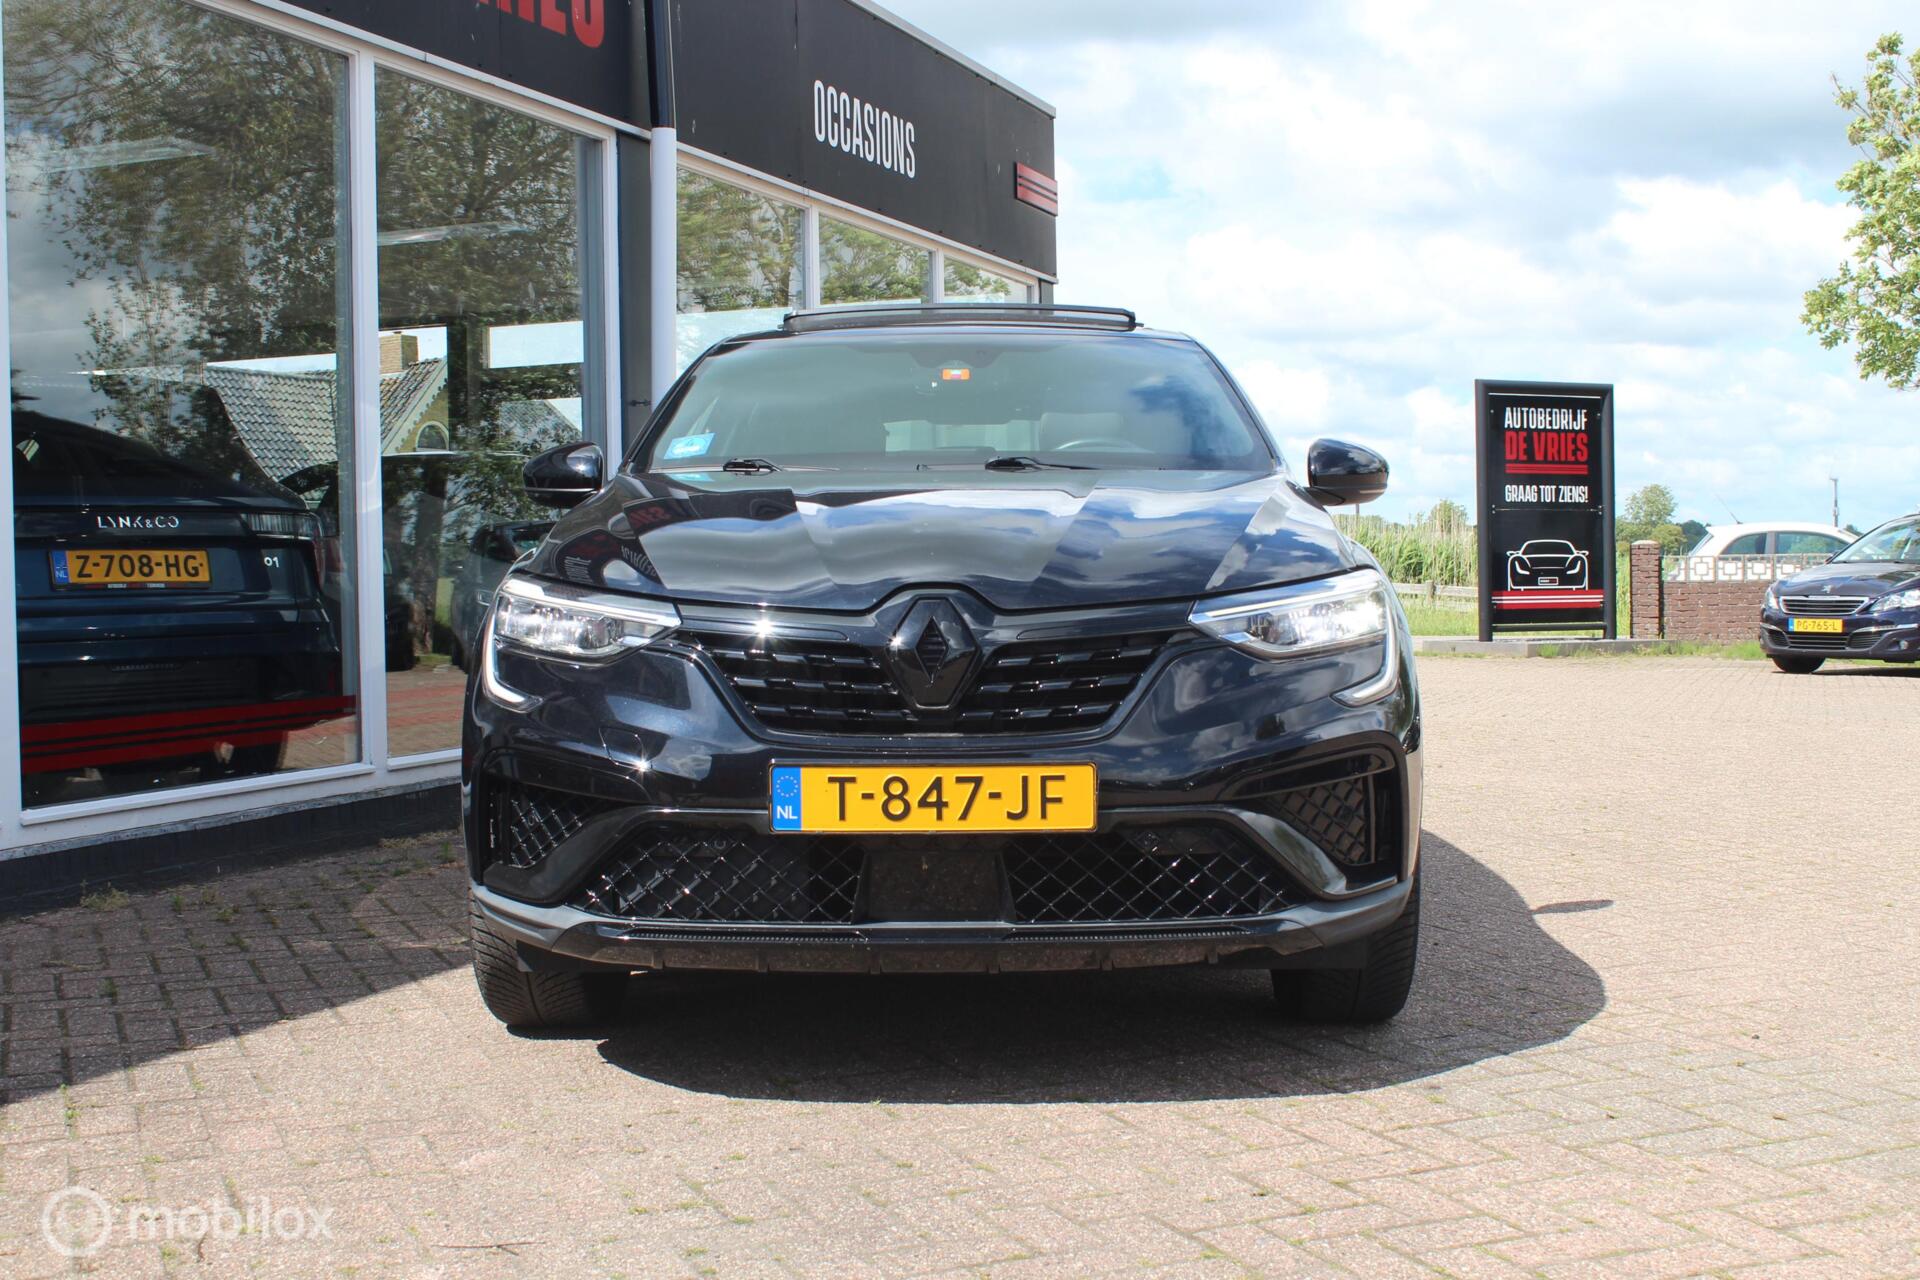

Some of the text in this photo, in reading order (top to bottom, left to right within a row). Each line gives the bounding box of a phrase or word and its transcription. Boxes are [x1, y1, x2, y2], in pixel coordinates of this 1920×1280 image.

[814, 80, 916, 179] OCCASIONS
[1504, 407, 1588, 430] AUTOBEDRIJF
[1505, 431, 1589, 462] DE VRIES
[1505, 484, 1589, 503] GRAAG TOT ZIENS!
[75, 554, 200, 578] Z-708-HG
[827, 775, 1066, 822] T-847-JF
[776, 805, 798, 819] NL
